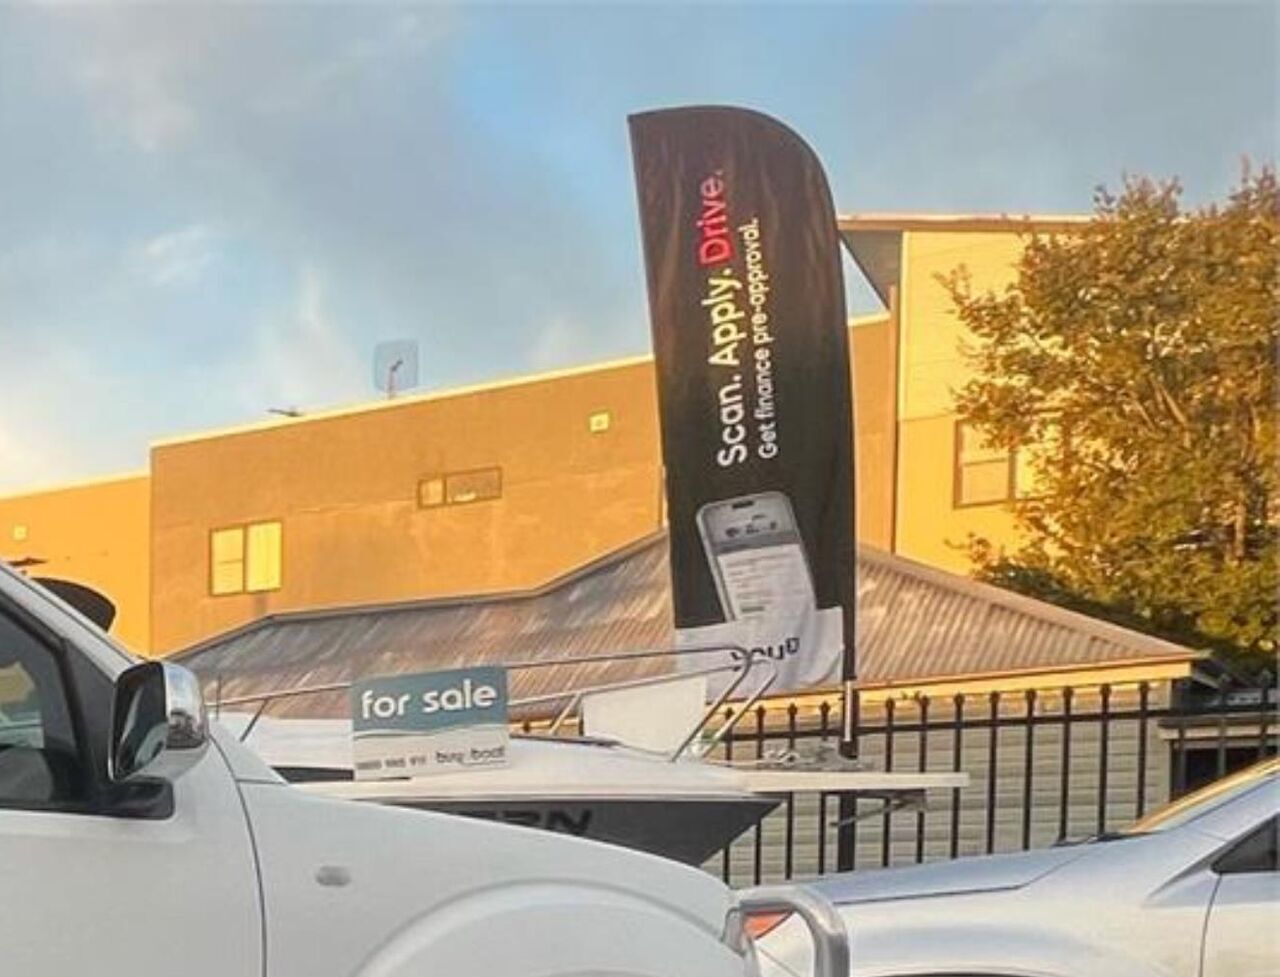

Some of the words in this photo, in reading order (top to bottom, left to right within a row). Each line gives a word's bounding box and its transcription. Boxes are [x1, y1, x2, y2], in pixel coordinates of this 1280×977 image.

[697, 169, 735, 265] Drive.
[702, 268, 745, 366] Apply.
[738, 217, 775, 344] pre-approval.
[717, 375, 746, 467] Scan.
[753, 349, 778, 420] finance
[758, 421, 778, 459] Get
[361, 690, 410, 719] for
[422, 678, 497, 713] sale
